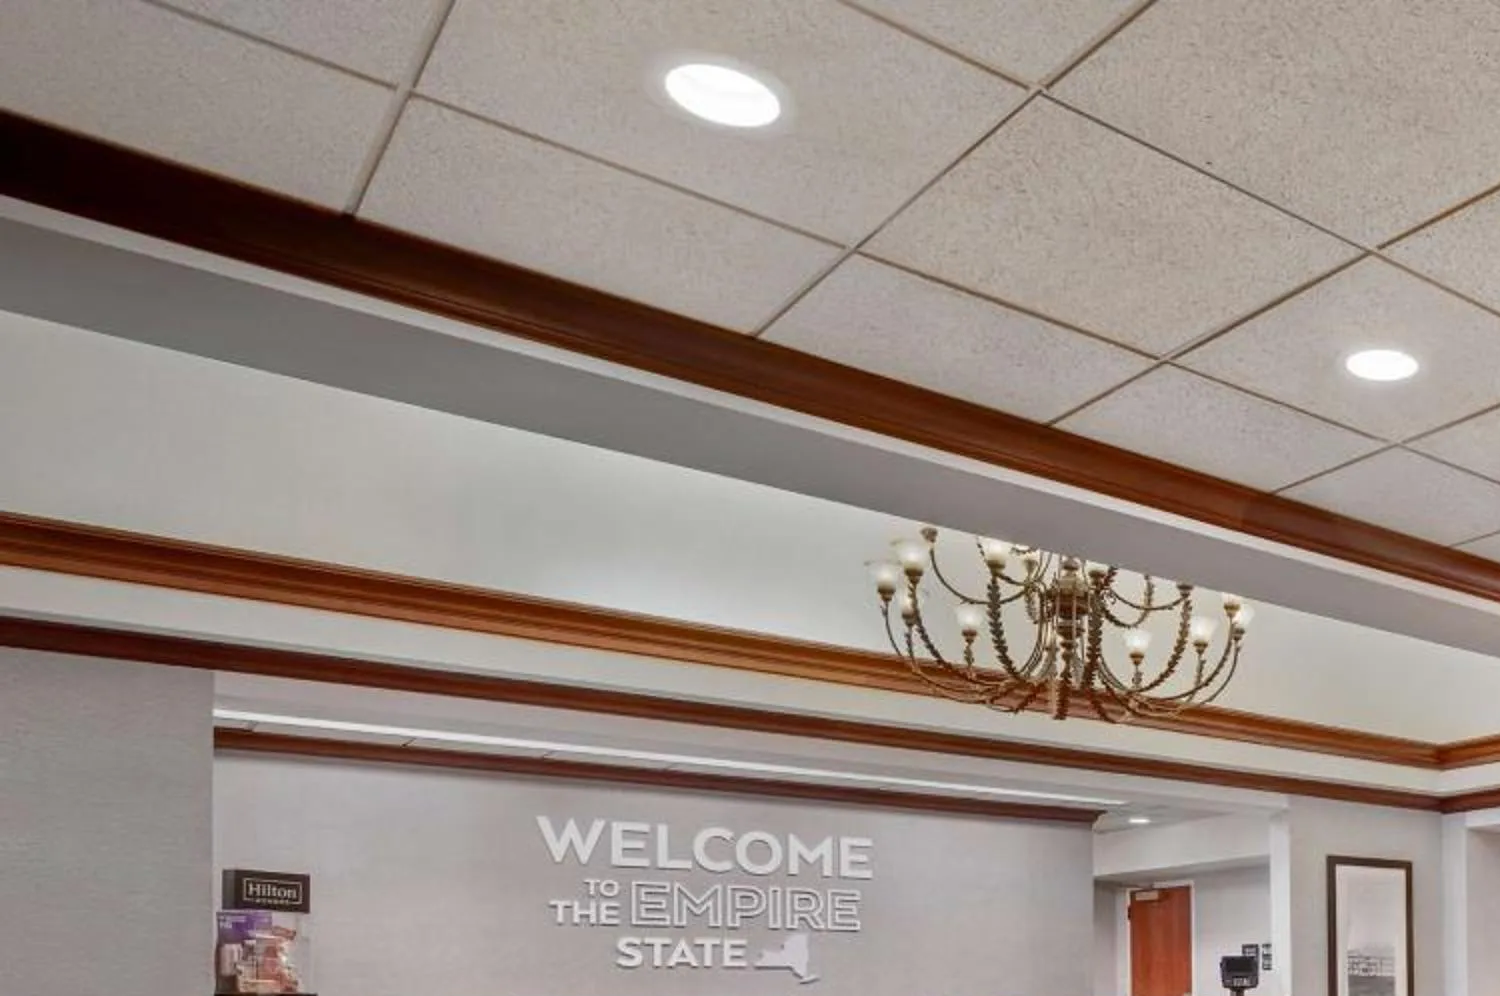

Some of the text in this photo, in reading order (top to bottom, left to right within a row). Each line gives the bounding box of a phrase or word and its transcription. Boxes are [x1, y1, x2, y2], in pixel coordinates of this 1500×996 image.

[535, 815, 874, 880] WELCOME
[247, 881, 297, 900] Hilton
[583, 878, 620, 898] TO
[548, 880, 862, 932] THE EMPIRE
[615, 936, 750, 969] STATE
